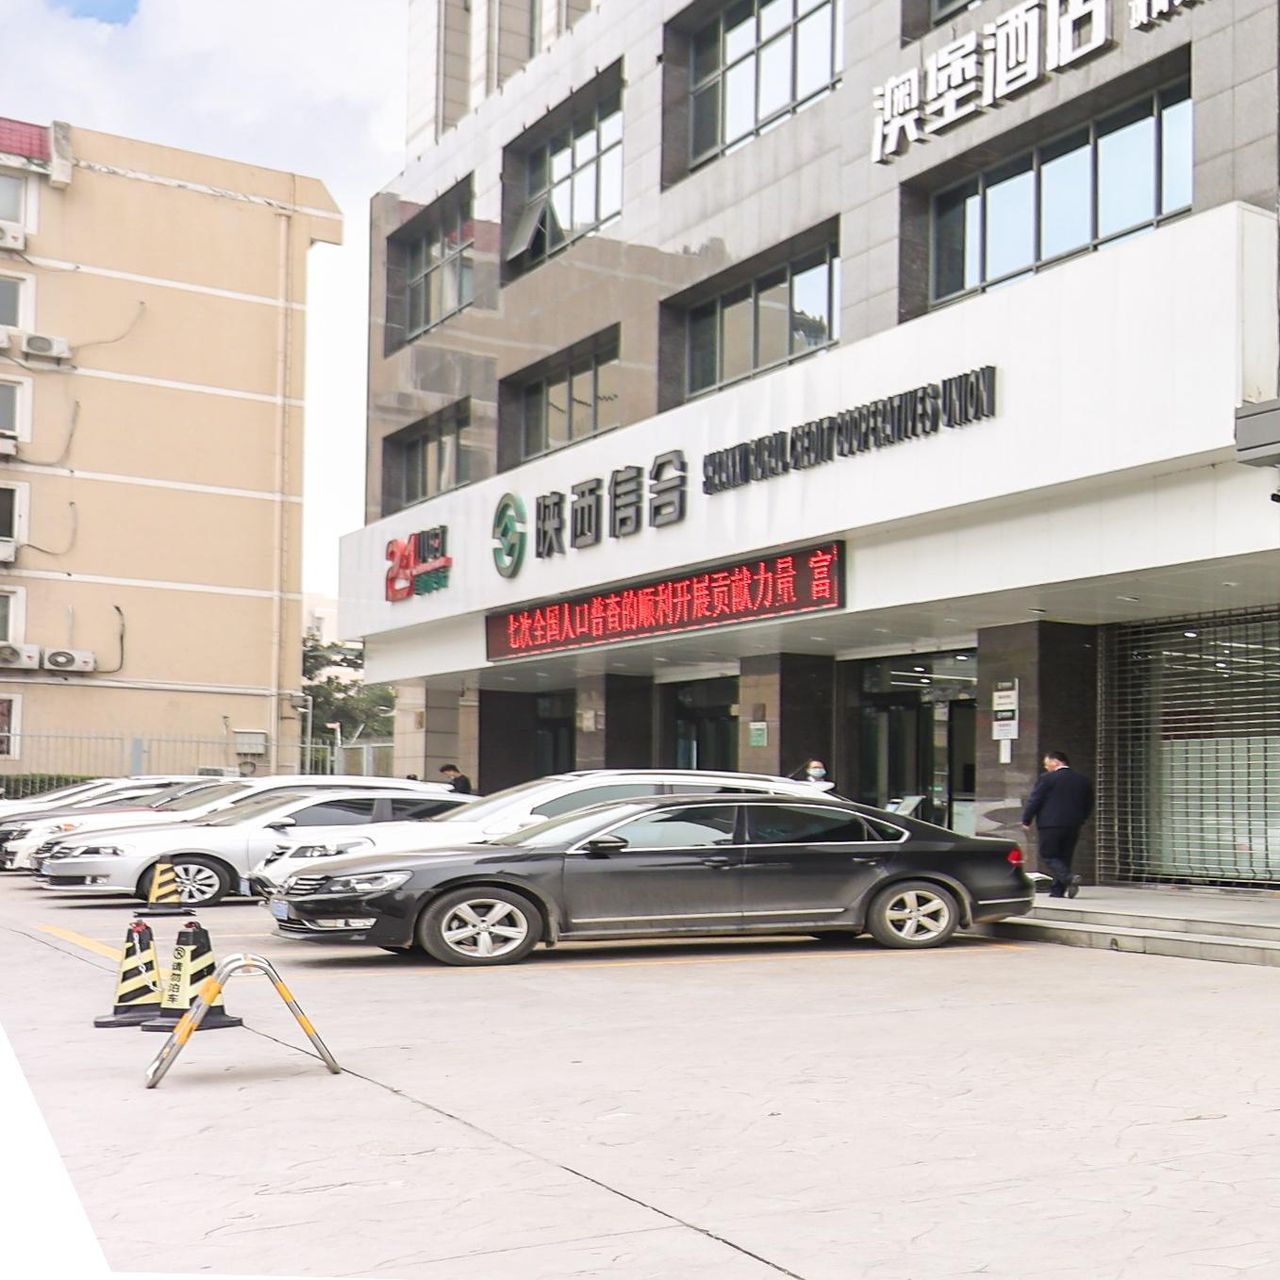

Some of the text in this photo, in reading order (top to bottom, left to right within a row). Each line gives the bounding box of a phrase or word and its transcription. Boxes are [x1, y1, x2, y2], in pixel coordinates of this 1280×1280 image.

[942, 365, 996, 428] UNION
[536, 450, 688, 558] 陕西信合
